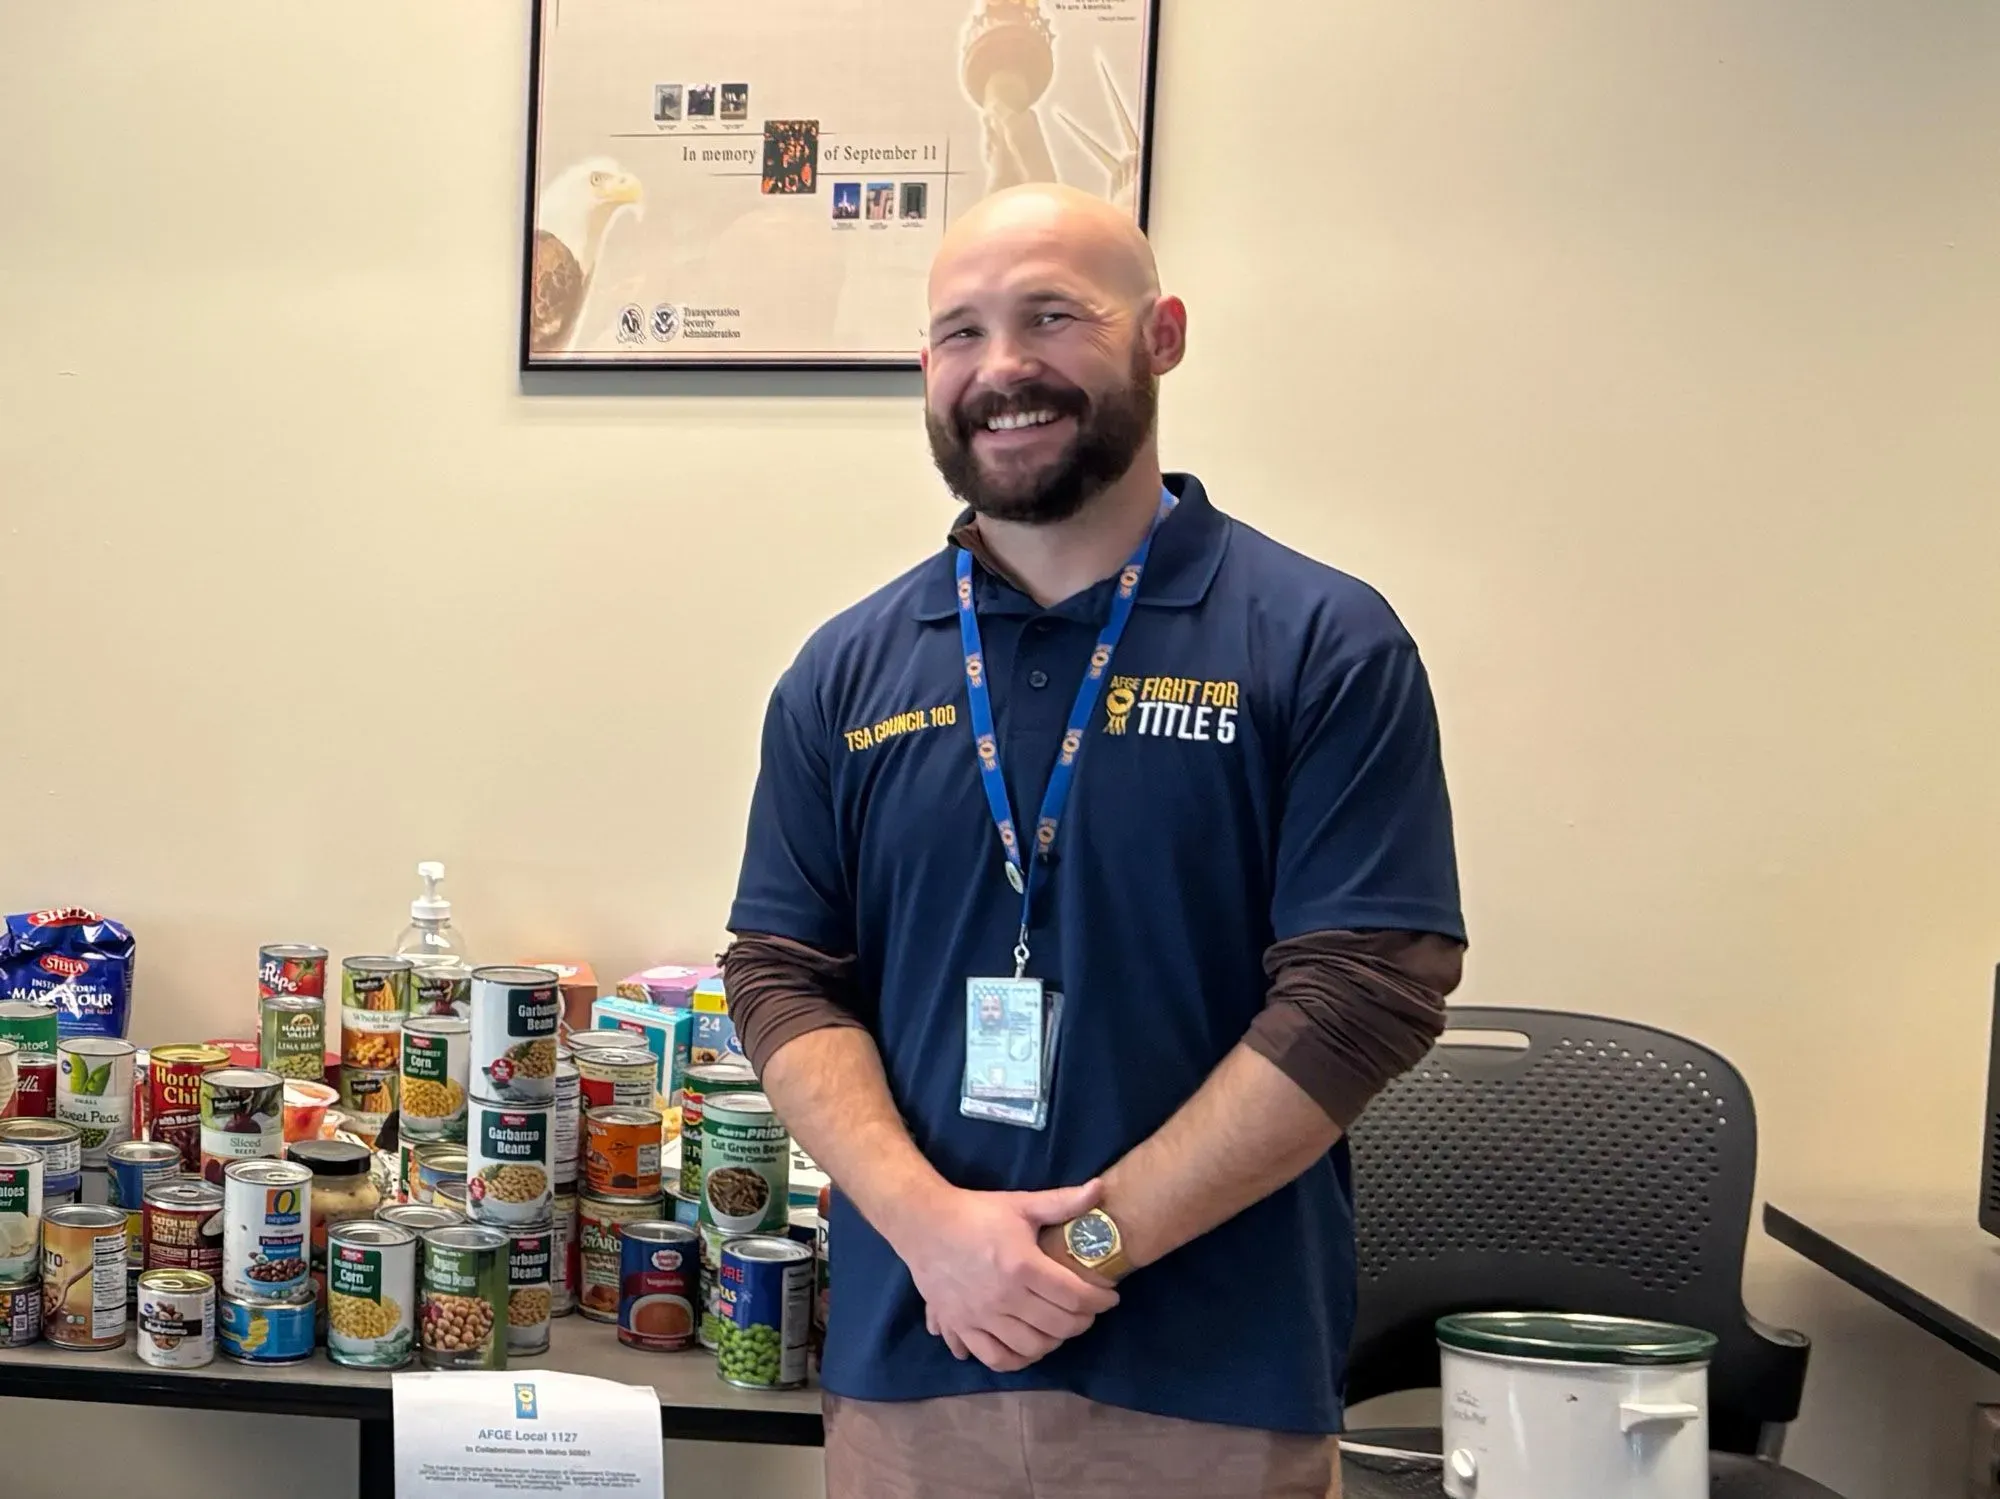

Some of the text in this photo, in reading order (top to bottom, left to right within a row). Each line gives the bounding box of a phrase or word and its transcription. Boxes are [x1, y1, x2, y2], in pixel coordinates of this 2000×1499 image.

[683, 146, 757, 165] In memory
[824, 145, 938, 164] of September 11
[683, 307, 741, 319] Transportation
[683, 318, 716, 329] Security
[683, 329, 741, 338] Administration
[1141, 677, 1239, 708] FIGHT FOR
[844, 704, 957, 753] TSA COUNCIL 100
[1137, 701, 1238, 744] TITLE 5
[46, 958, 85, 974] STELLA
[71, 983, 97, 992] CORN
[527, 1017, 554, 1031] Beans
[700, 1016, 721, 1032] 24
[410, 1055, 432, 1069] Corn
[59, 1105, 120, 1124] Sweet Peas
[488, 1126, 540, 1142] Garbanzo
[230, 1137, 262, 1149] Sliced
[497, 1141, 532, 1155] Beans
[711, 1139, 726, 1150] Cut
[727, 1142, 761, 1153] Green
[179, 1219, 198, 1229] YOU
[510, 1251, 549, 1266] arbanzo
[340, 1269, 365, 1284] Corn
[511, 1266, 543, 1280] Beans
[478, 1429, 579, 1444] AFGE Local 1127
[465, 1445, 474, 1453] In
[475, 1445, 526, 1455] Collaboration
[527, 1447, 545, 1456] with
